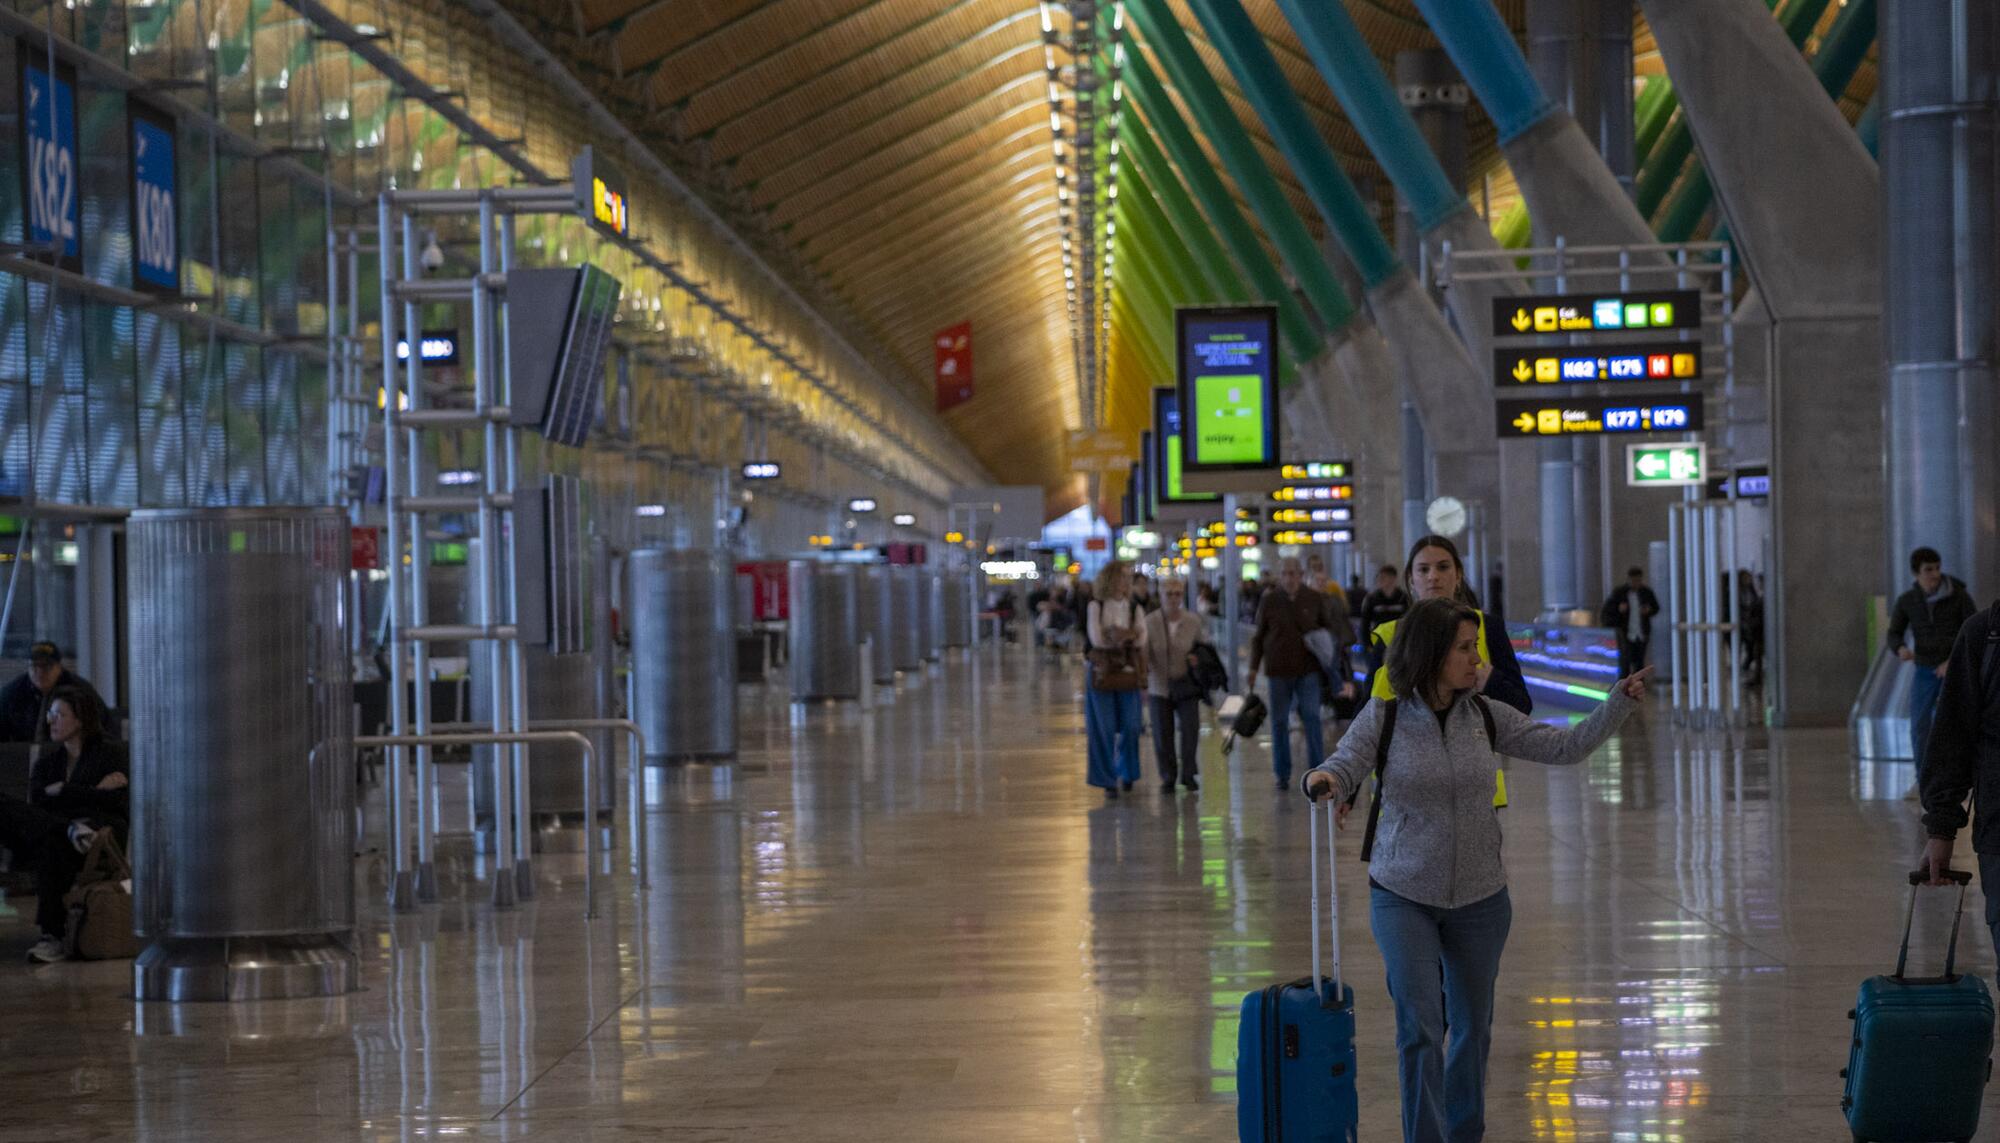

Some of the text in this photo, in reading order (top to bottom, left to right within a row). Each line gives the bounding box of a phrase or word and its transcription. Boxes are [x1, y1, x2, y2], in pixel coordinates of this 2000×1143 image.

[27, 132, 75, 240] K82
[136, 178, 176, 273] K80
[1606, 409, 1638, 428] K77
